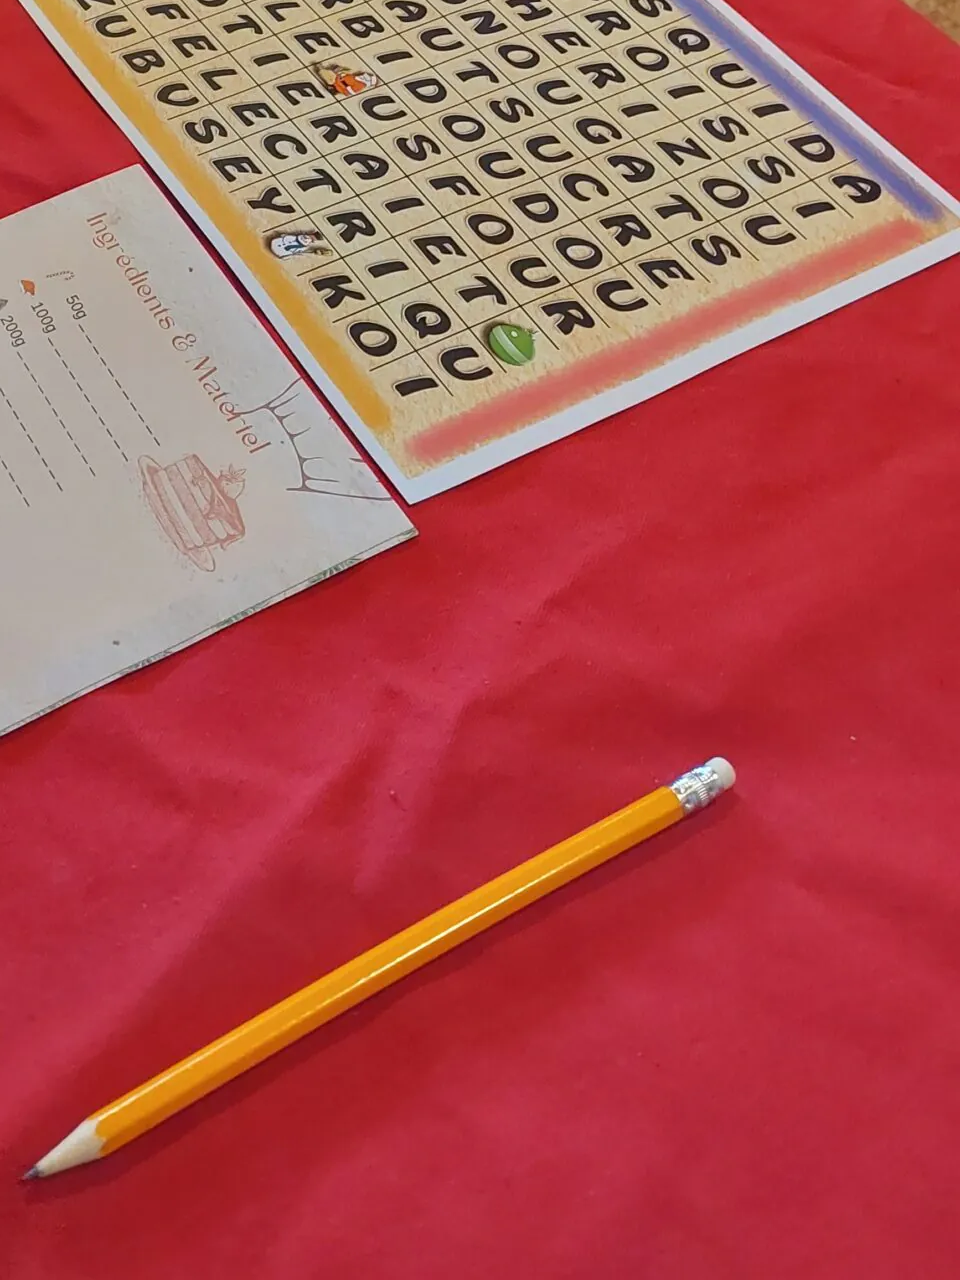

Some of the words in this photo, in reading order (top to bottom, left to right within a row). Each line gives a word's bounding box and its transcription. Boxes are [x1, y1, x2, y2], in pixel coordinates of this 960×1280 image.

[95, 15, 137, 38] U
[122, 49, 165, 74] B
[184, 118, 228, 144] S
[212, 156, 262, 183] E
[247, 187, 296, 214] Y
[311, 275, 366, 309] K
[349, 321, 398, 357] O
[145, 3, 189, 20] F
[171, 35, 218, 58] E
[200, 68, 237, 91] L
[230, 102, 279, 127] E
[263, 133, 308, 160] C
[296, 168, 342, 194] T
[326, 211, 376, 243] R
[404, 302, 452, 339] Q
[440, 346, 493, 381] U
[222, 14, 263, 35] T
[276, 82, 325, 106] E
[310, 115, 358, 143] R
[343, 153, 389, 180] A
[413, 235, 467, 265] E
[458, 275, 507, 305] T
[264, 2, 300, 22] L
[293, 32, 341, 54] E
[361, 95, 407, 121] U
[396, 134, 441, 162] S
[428, 175, 481, 196] F
[467, 213, 514, 245] O
[510, 257, 561, 289] U
[540, 300, 595, 335] R
[340, 15, 385, 39] B
[404, 78, 447, 104] D
[441, 114, 486, 142] O
[478, 151, 526, 180] U
[512, 193, 559, 223] D
[555, 237, 603, 270] O
[596, 279, 649, 312] U
[385, 0, 428, 23] A
[420, 27, 465, 52] U
[455, 61, 499, 84] T
[489, 97, 534, 123] S
[526, 135, 574, 163] U
[562, 173, 610, 202] C
[599, 214, 652, 247] R
[638, 259, 695, 289] E
[460, 10, 508, 35] N
[497, 44, 540, 69] O
[536, 79, 583, 105] U
[575, 118, 623, 145] G
[607, 155, 655, 183] A
[654, 194, 703, 222] T
[691, 235, 741, 266] S
[542, 31, 591, 54] E
[577, 62, 626, 89] R
[656, 137, 712, 166] Z
[702, 178, 749, 209] O
[744, 215, 797, 246] U
[584, 10, 631, 36] R
[626, 46, 670, 72] O
[702, 116, 749, 143] S
[747, 155, 795, 184] S
[667, 28, 710, 55] Q
[709, 63, 757, 89] U
[788, 134, 835, 163] D
[831, 175, 882, 204] A
[0, 315, 26, 348] 200g
[30, 301, 57, 334] 100g
[66, 294, 87, 320] 50g
[86, 212, 175, 330] Ingrédients
[171, 332, 197, 352] &
[184, 355, 272, 454] Matériel
